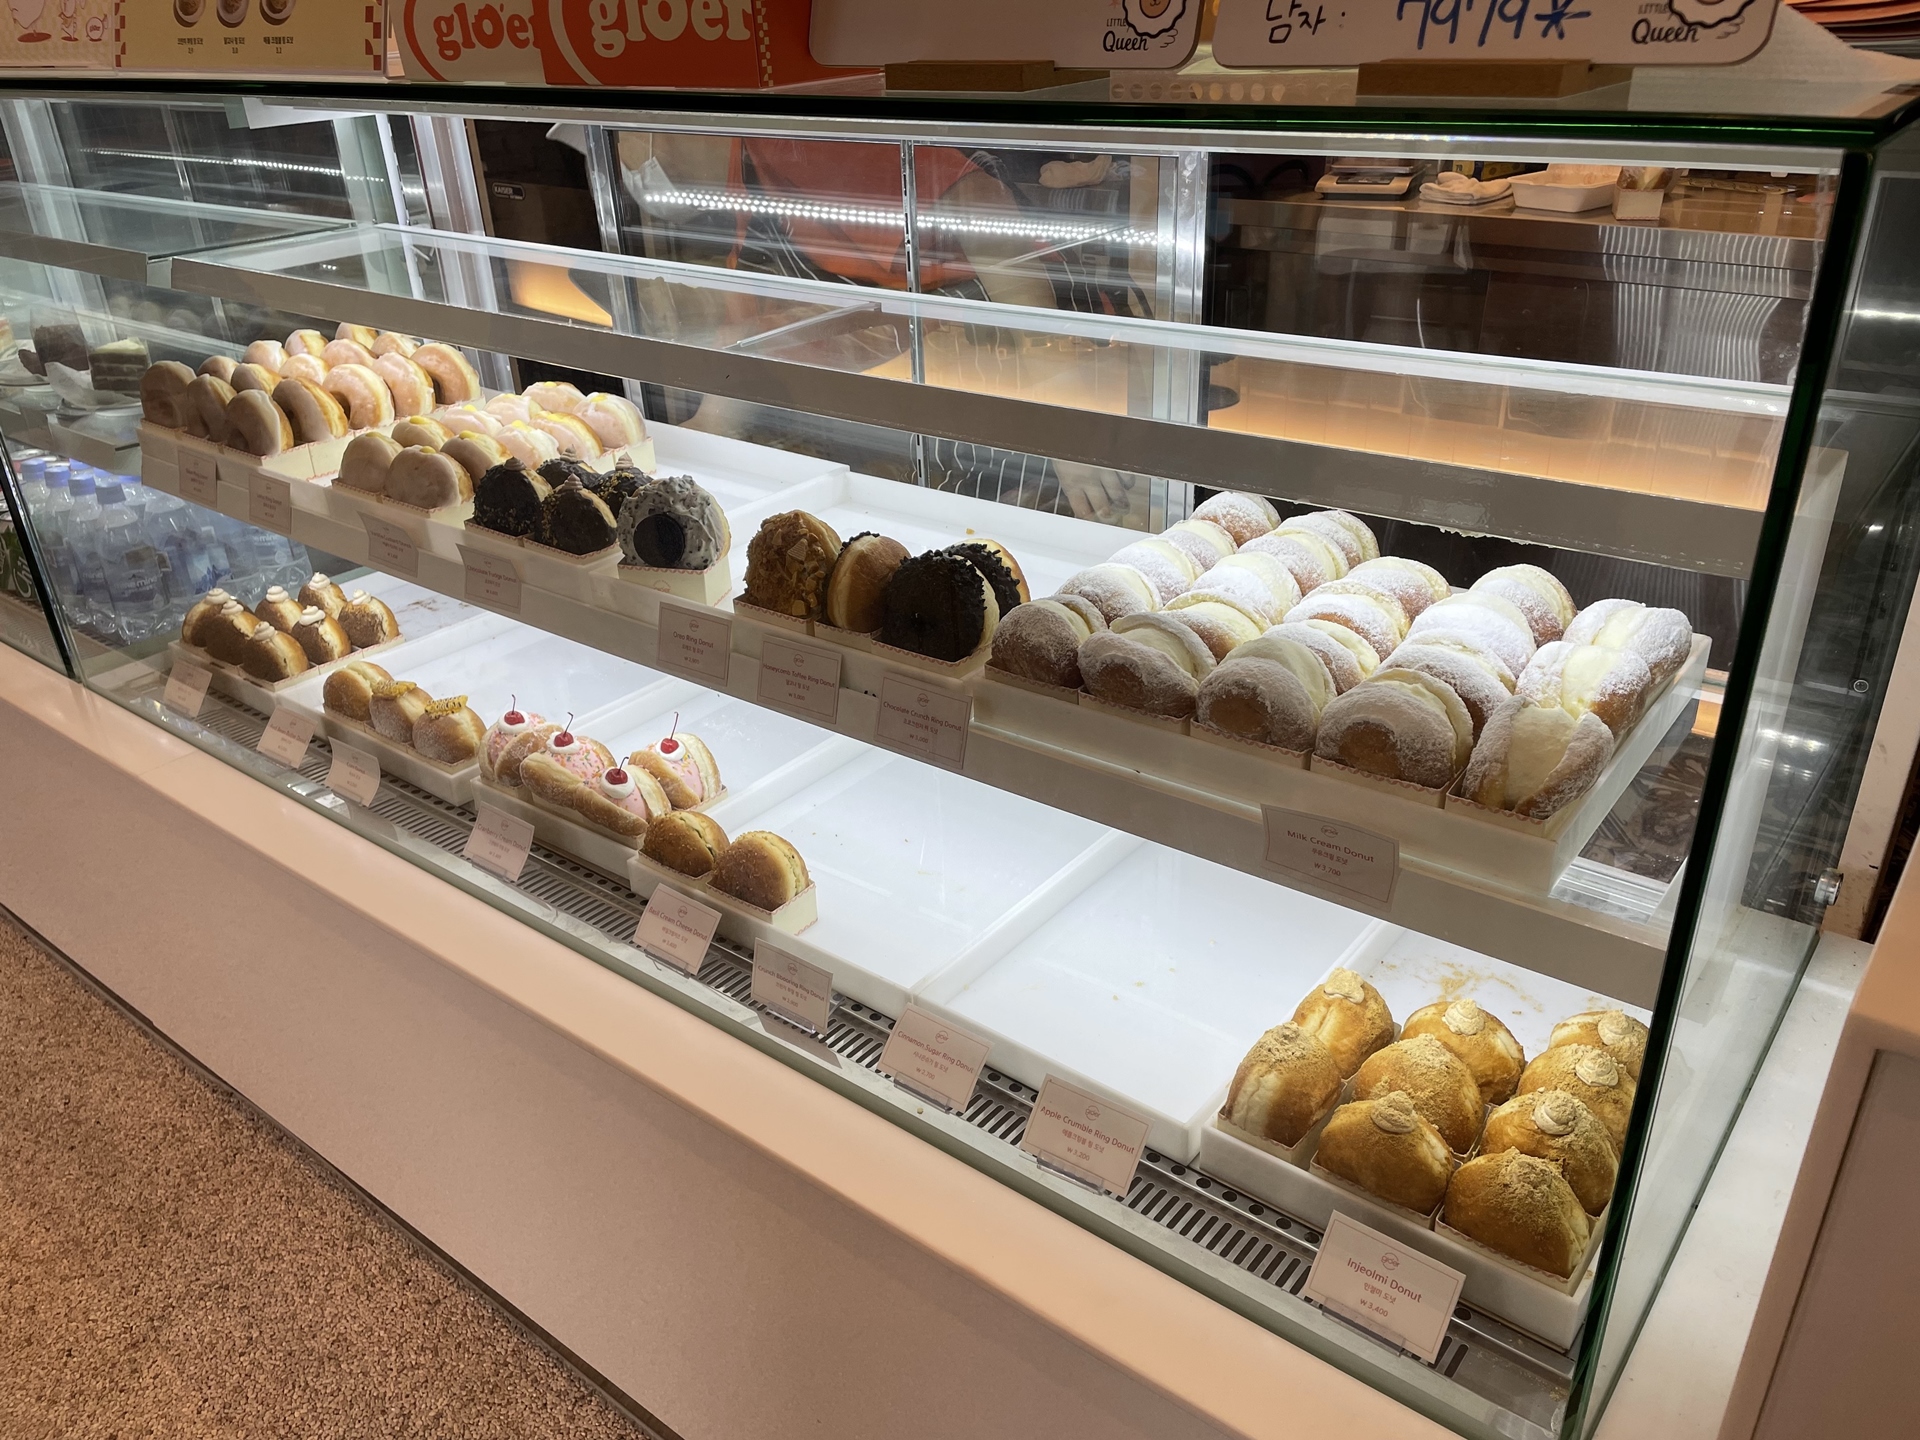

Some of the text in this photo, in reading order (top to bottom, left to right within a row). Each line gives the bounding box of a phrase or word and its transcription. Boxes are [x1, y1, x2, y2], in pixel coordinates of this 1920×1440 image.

[1103, 30, 1149, 52] Queen
[1631, 18, 1699, 44] Queen
[673, 631, 714, 648] Oreo Ring Donut
[762, 663, 835, 688] Honeycomb Toffee Ring Donut
[883, 701, 962, 732] Chocolate Crunch Ring Donut
[1287, 830, 1374, 863] Milk Cream Donut
[649, 907, 707, 941] Basil Cream Cheese Donut
[810, 990, 824, 1002] Donut
[898, 1031, 974, 1074] Cinnamon Sugar Ring Donut
[1040, 1106, 1135, 1154] Apple Crumble Ring Donut
[1347, 1257, 1423, 1303] Injeolmi Donut
[1368, 1302, 1389, 1317] 3,400
[1382, 1293, 1397, 1305] 도넛
